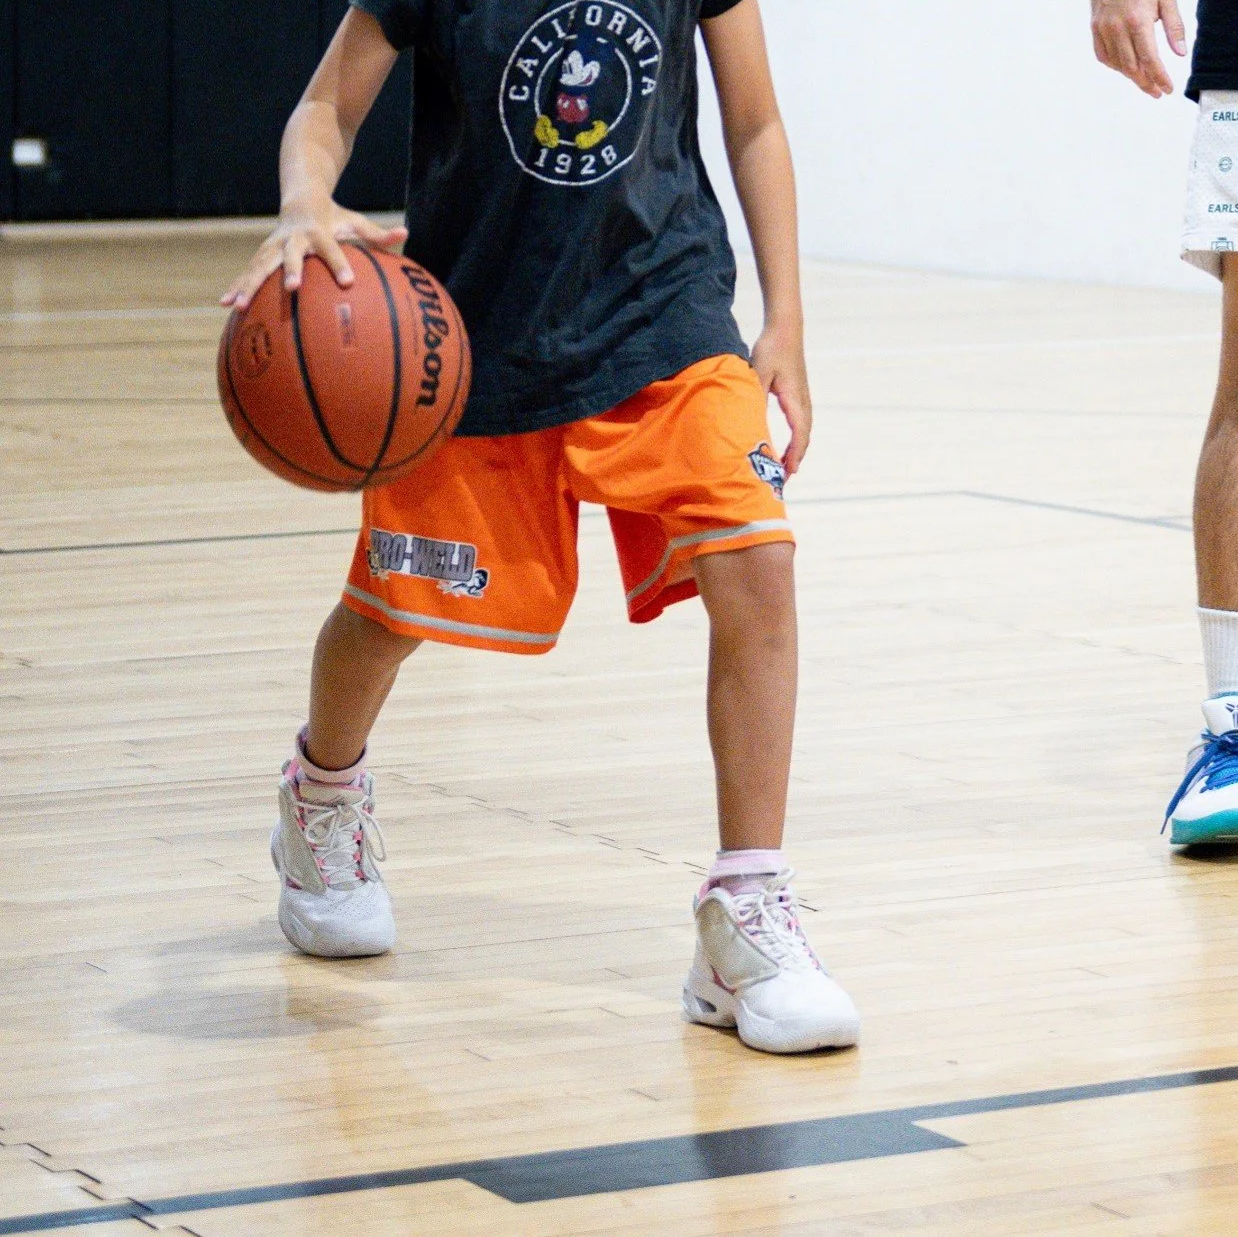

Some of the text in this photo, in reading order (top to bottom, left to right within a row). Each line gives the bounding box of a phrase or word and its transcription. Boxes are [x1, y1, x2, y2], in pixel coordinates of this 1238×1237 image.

[508, 4, 660, 101] CALIORNIA
[534, 144, 618, 174] 1928
[401, 264, 450, 407] Wilson
